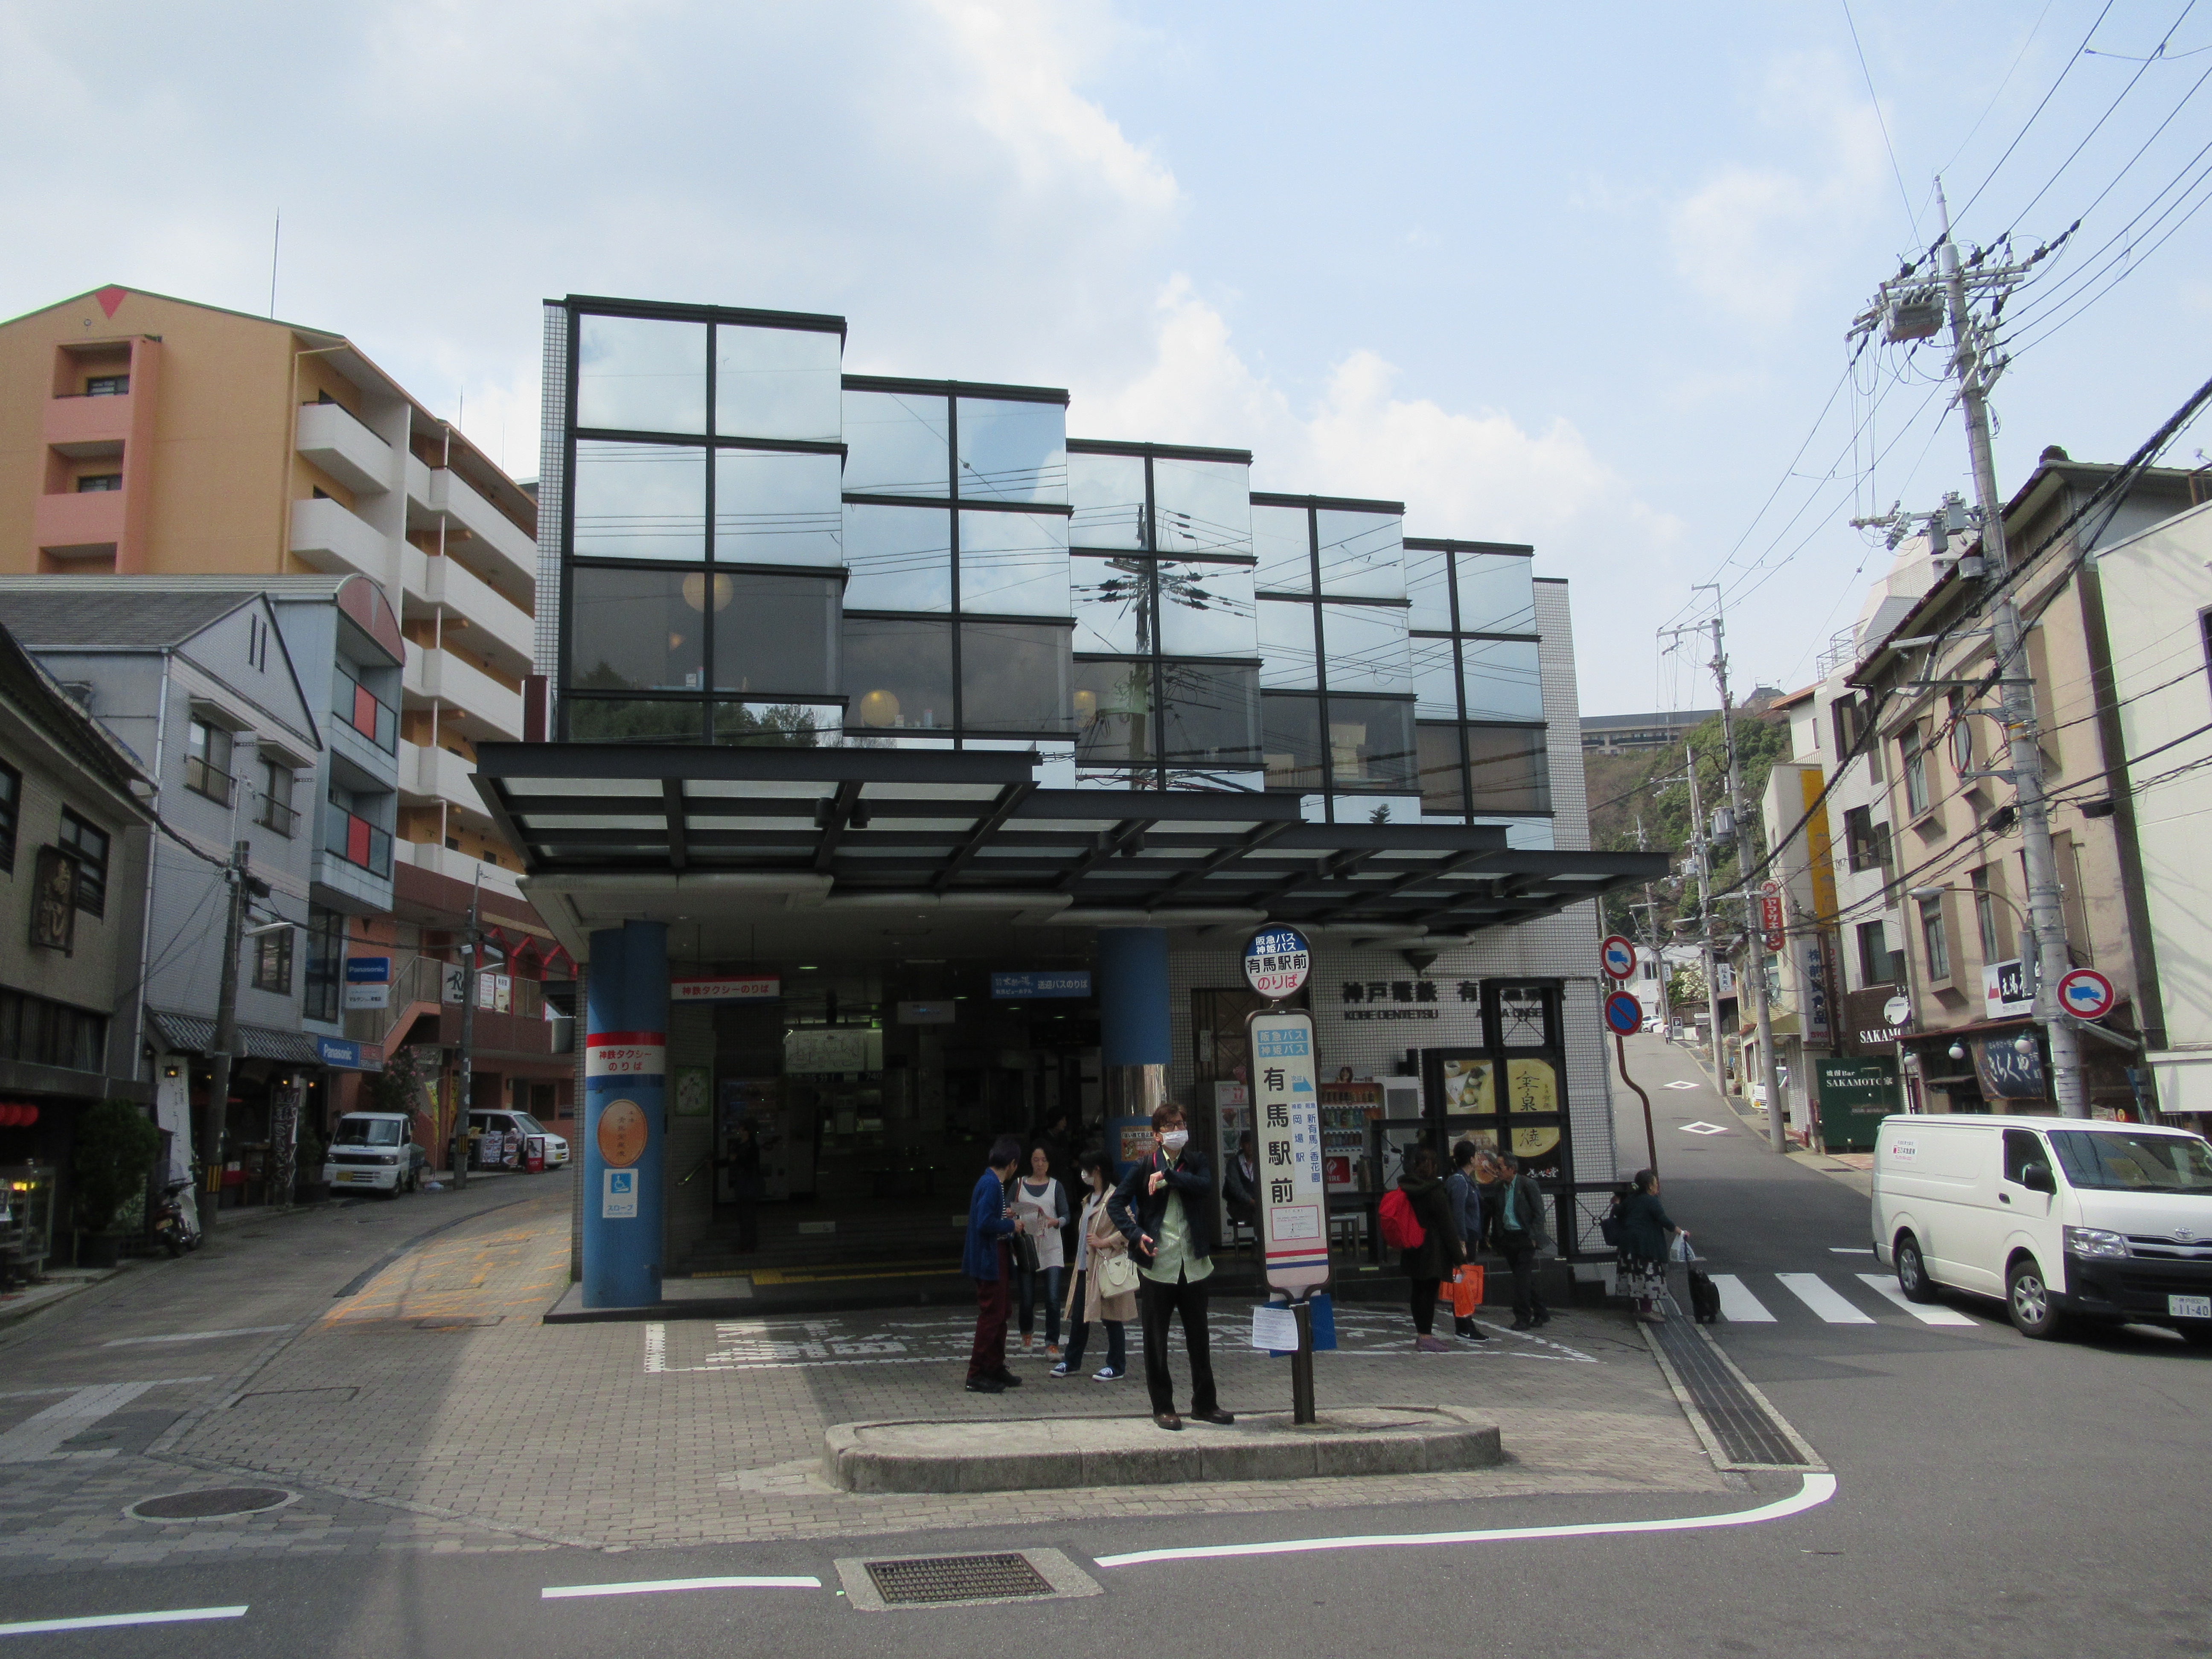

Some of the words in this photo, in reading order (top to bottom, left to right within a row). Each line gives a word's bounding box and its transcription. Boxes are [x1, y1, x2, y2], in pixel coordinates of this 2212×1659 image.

[1255, 933, 1295, 946] 阪急バス
[1256, 942, 1296, 955] 神姫バス
[1247, 953, 1307, 974] 有馬駅前
[1038, 979, 1088, 990] 送迎バスのりば
[1257, 973, 1298, 990] のりば
[682, 984, 769, 995] 神鉄タクシーのりば
[1343, 981, 1438, 1003] 神戸電鉄
[1344, 1010, 1377, 1020] KOBE
[1260, 1030, 1304, 1042] 阪急バス
[323, 1043, 352, 1061] Panasonic
[599, 1050, 652, 1060] 神鉄タクシー
[1261, 1043, 1305, 1055] 神姫バス
[608, 1061, 643, 1071] のりば
[1263, 1066, 1293, 1204] 有馬駅前
[1293, 1114, 1305, 1163] 岡場駅
[2180, 1304, 2209, 1316] 11-40
